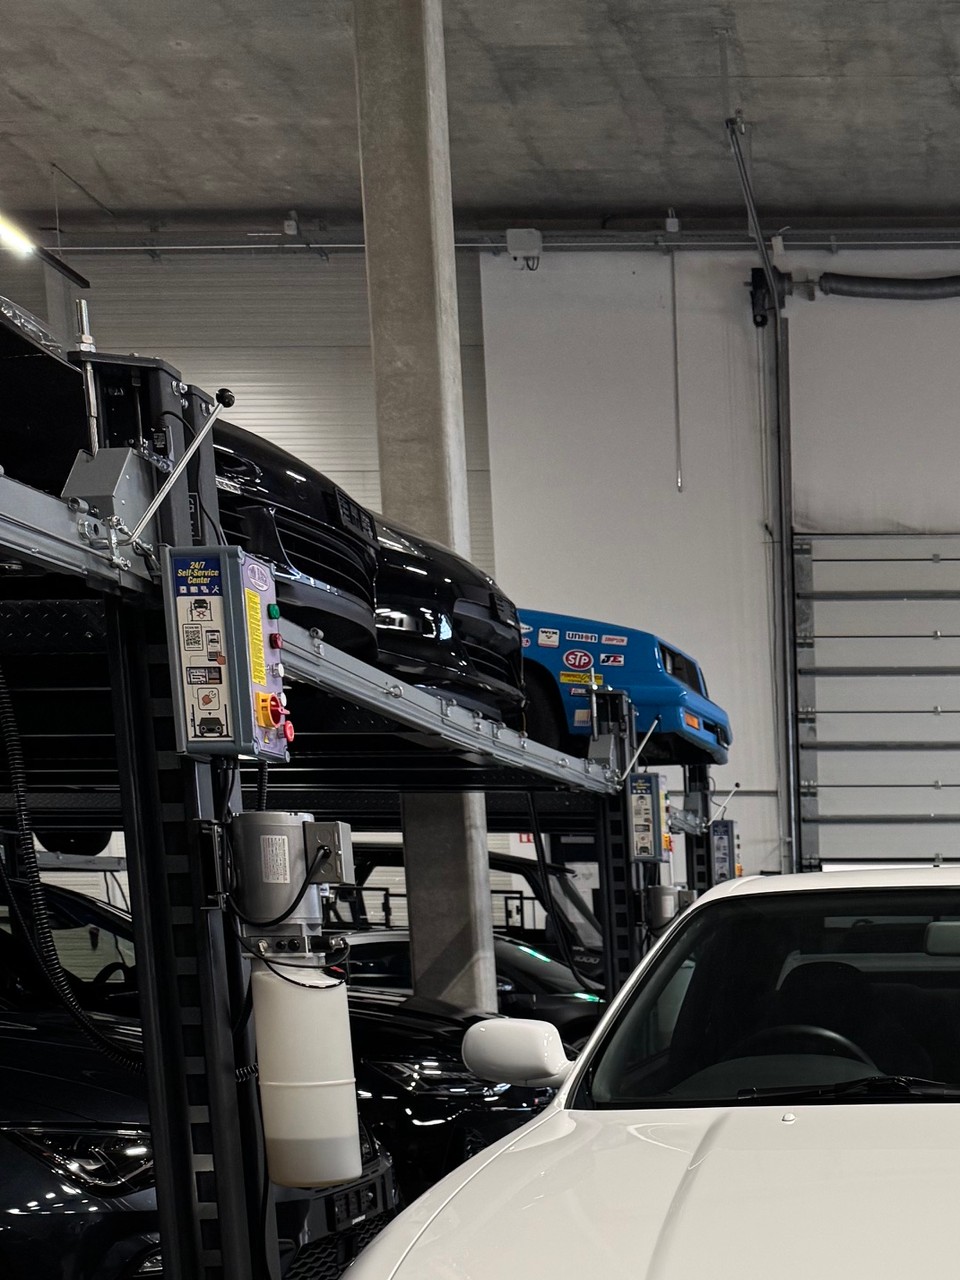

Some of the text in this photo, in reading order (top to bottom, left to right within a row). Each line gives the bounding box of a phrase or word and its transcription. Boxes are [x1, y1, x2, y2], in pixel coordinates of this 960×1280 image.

[177, 569, 219, 577] Self-Service
[568, 652, 589, 666] STP
[601, 655, 623, 664] JE
